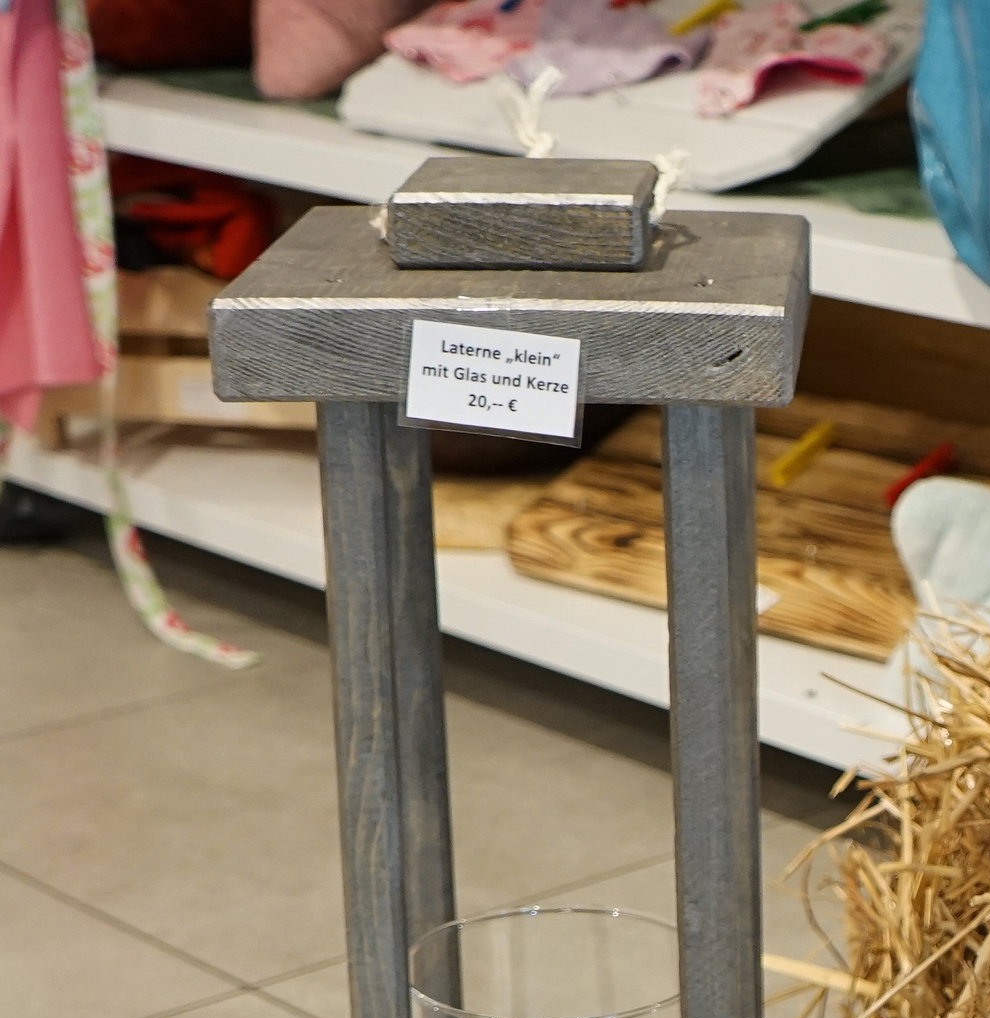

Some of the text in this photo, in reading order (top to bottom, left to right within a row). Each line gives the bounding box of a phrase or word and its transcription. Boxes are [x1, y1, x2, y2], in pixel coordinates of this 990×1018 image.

[441, 340, 560, 367] Laterne „klein“
[421, 364, 570, 394] mit Glas und Kerze
[467, 393, 518, 412] 20,-- €
